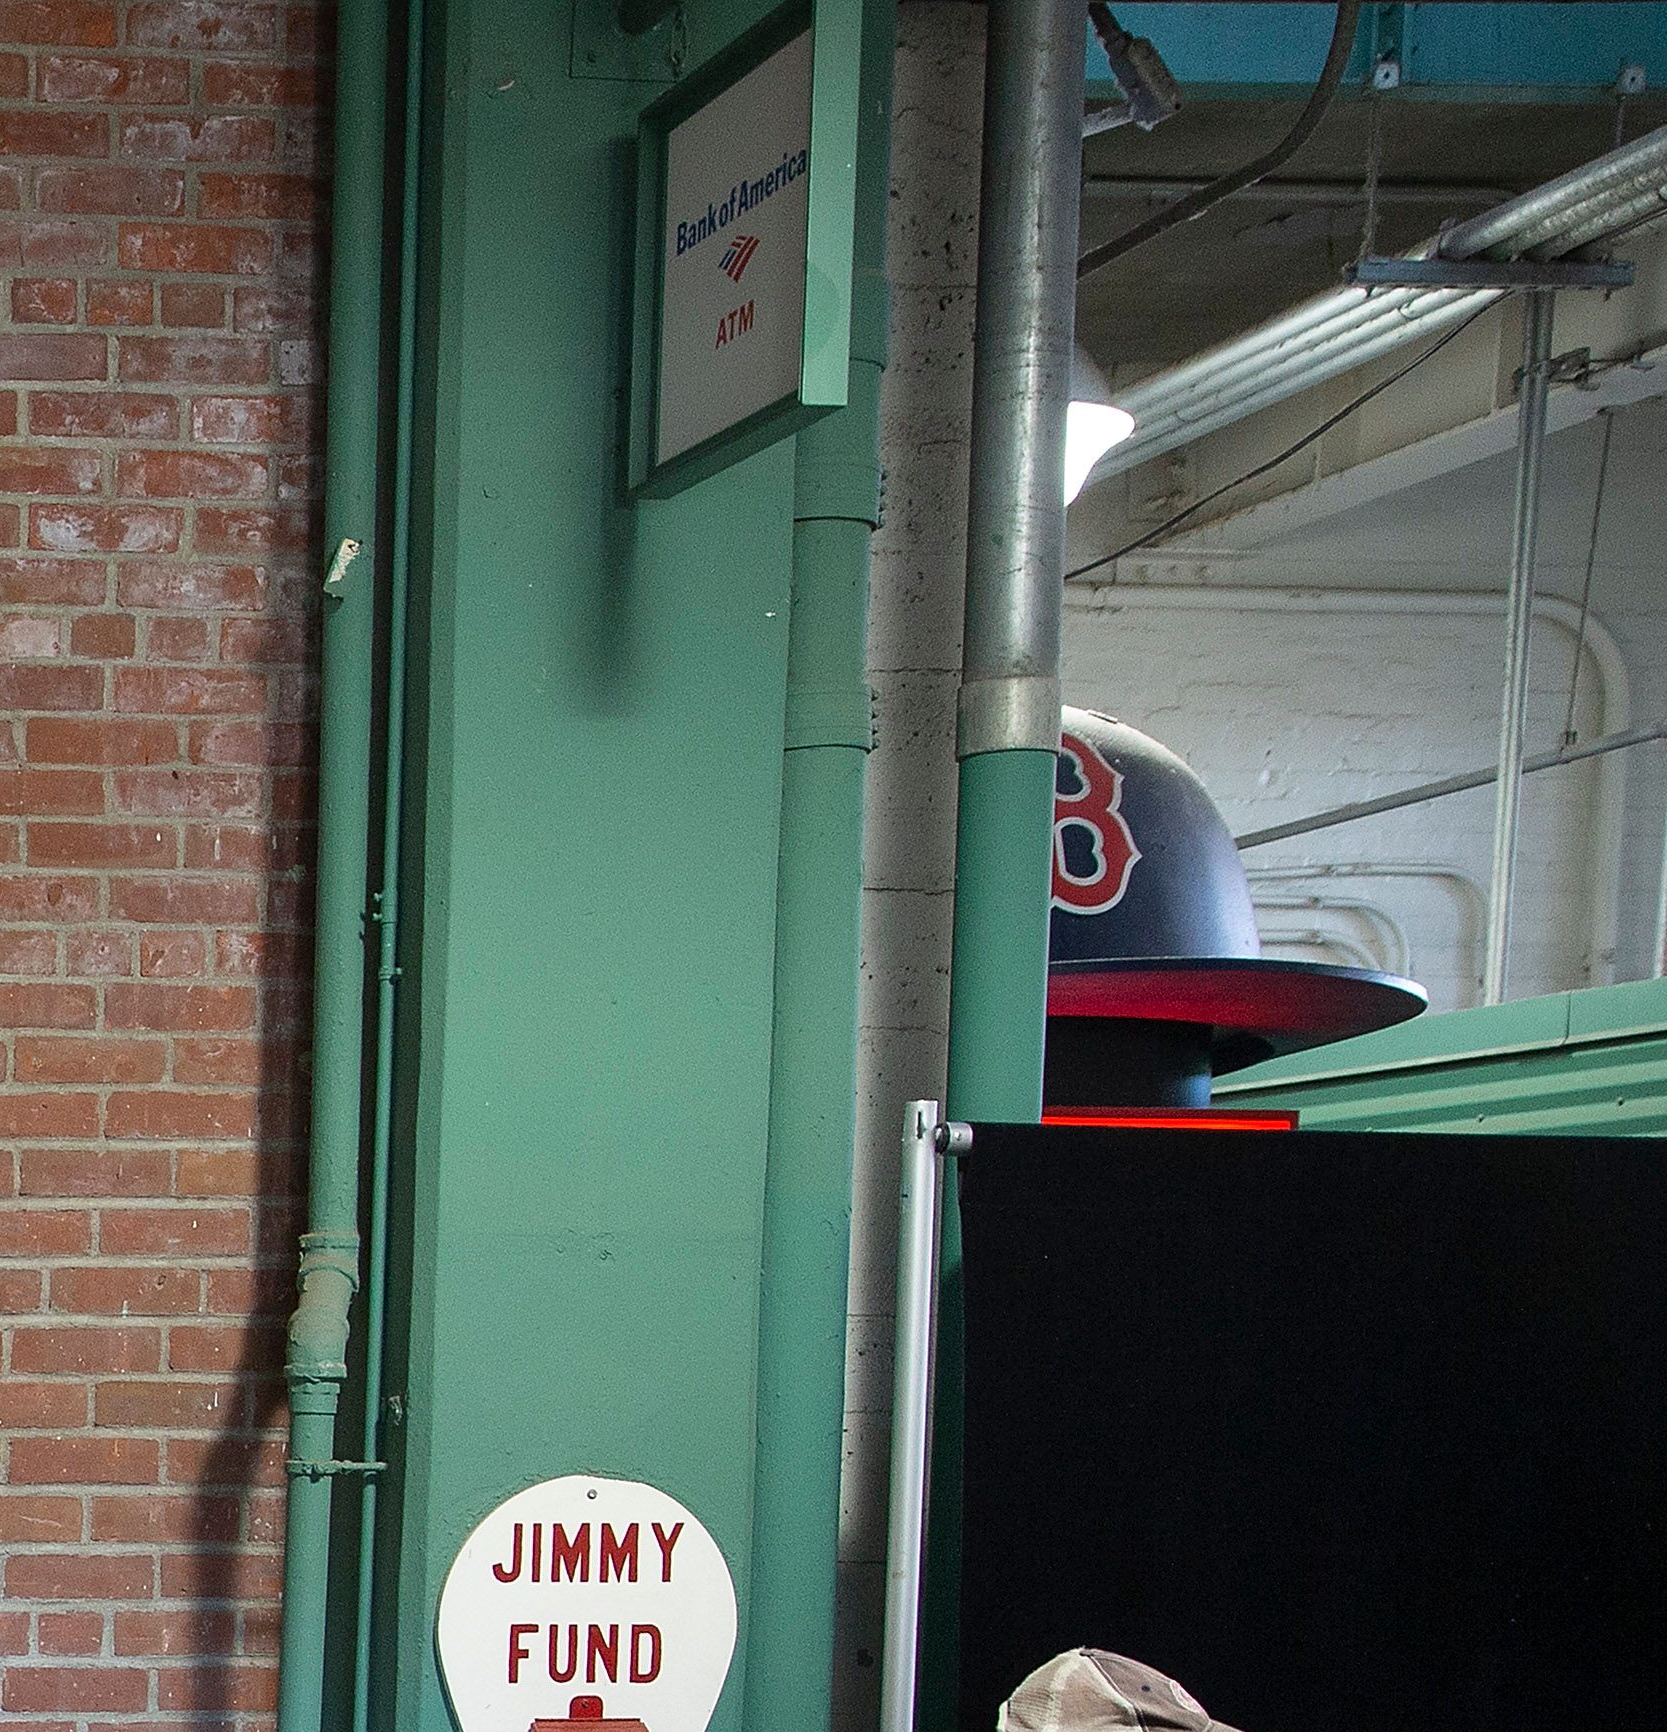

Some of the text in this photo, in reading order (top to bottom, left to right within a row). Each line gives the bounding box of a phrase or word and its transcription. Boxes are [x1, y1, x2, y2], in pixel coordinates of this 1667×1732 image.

[675, 149, 807, 256] Bank of America
[715, 300, 756, 350] ATM
[1050, 731, 1143, 916] B
[492, 1522, 685, 1584] JIMMY
[507, 1623, 663, 1684] FUND
